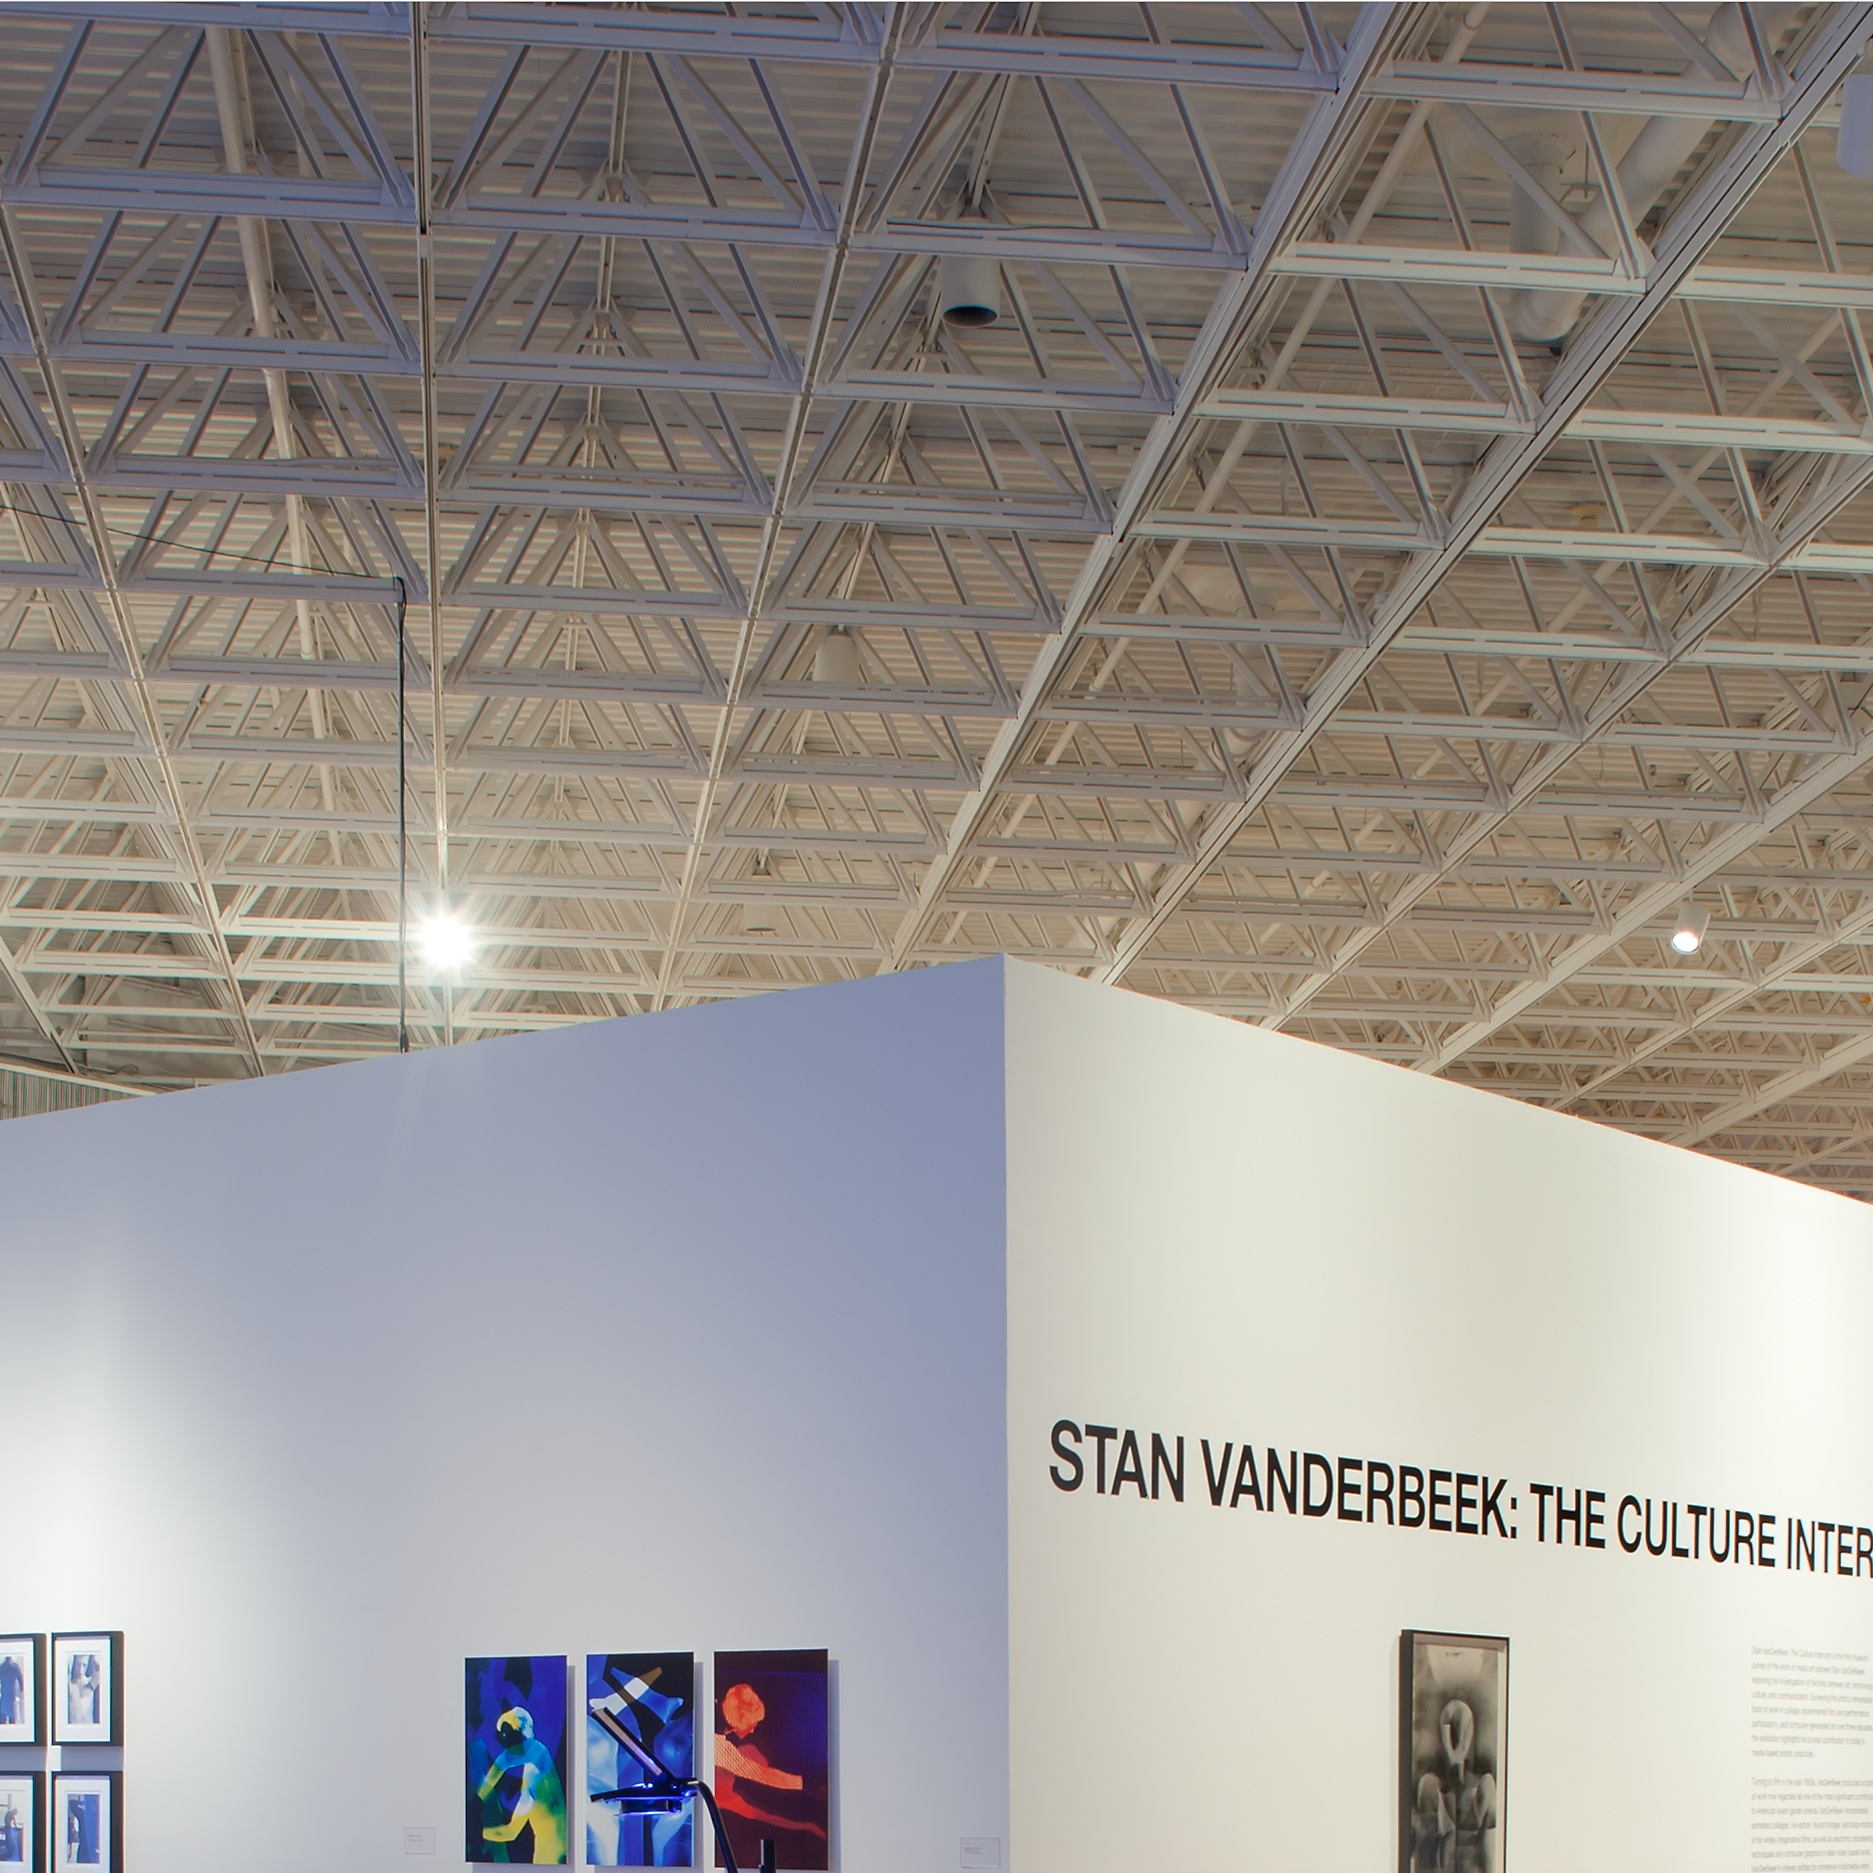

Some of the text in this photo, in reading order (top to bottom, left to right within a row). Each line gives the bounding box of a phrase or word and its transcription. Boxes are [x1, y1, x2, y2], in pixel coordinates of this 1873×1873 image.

[1049, 1418, 1185, 1503] STAN
[1200, 1438, 1518, 1541] VANDERBEEK:
[1529, 1482, 1606, 1549] THE
[1617, 1494, 1776, 1568] CULTURE
